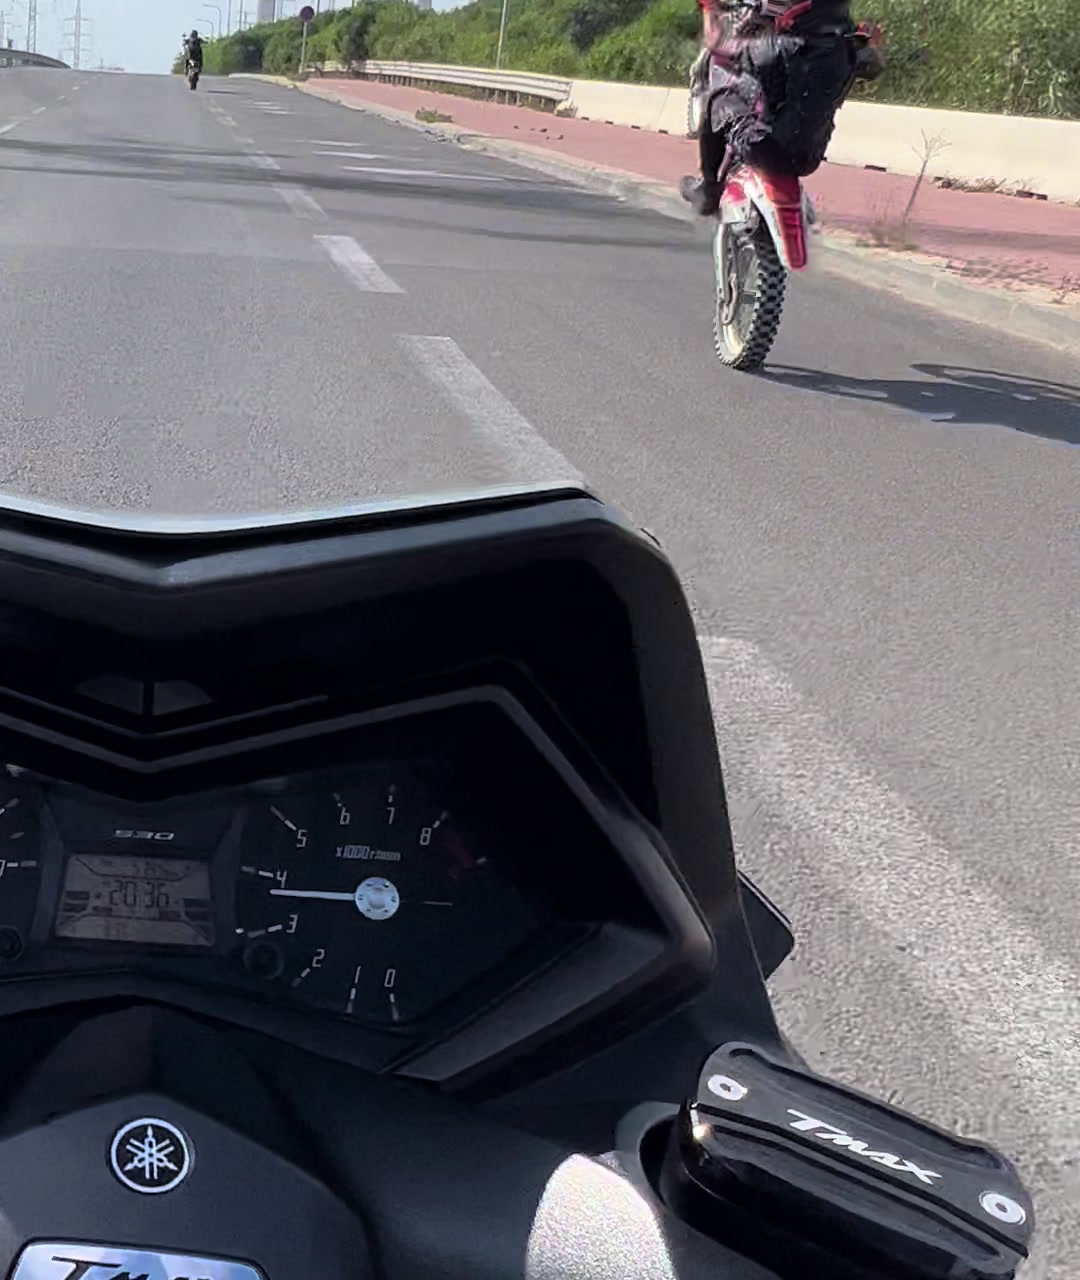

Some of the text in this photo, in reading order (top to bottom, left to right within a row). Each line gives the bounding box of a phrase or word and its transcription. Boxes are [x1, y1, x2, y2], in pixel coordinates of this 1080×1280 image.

[339, 807, 351, 825] 6
[386, 807, 395, 825] 7
[296, 829, 308, 848] 5
[419, 827, 432, 846] 8
[276, 870, 287, 888] 4
[286, 914, 298, 933] 3
[312, 948, 326, 968] 2
[384, 968, 396, 988] 0
